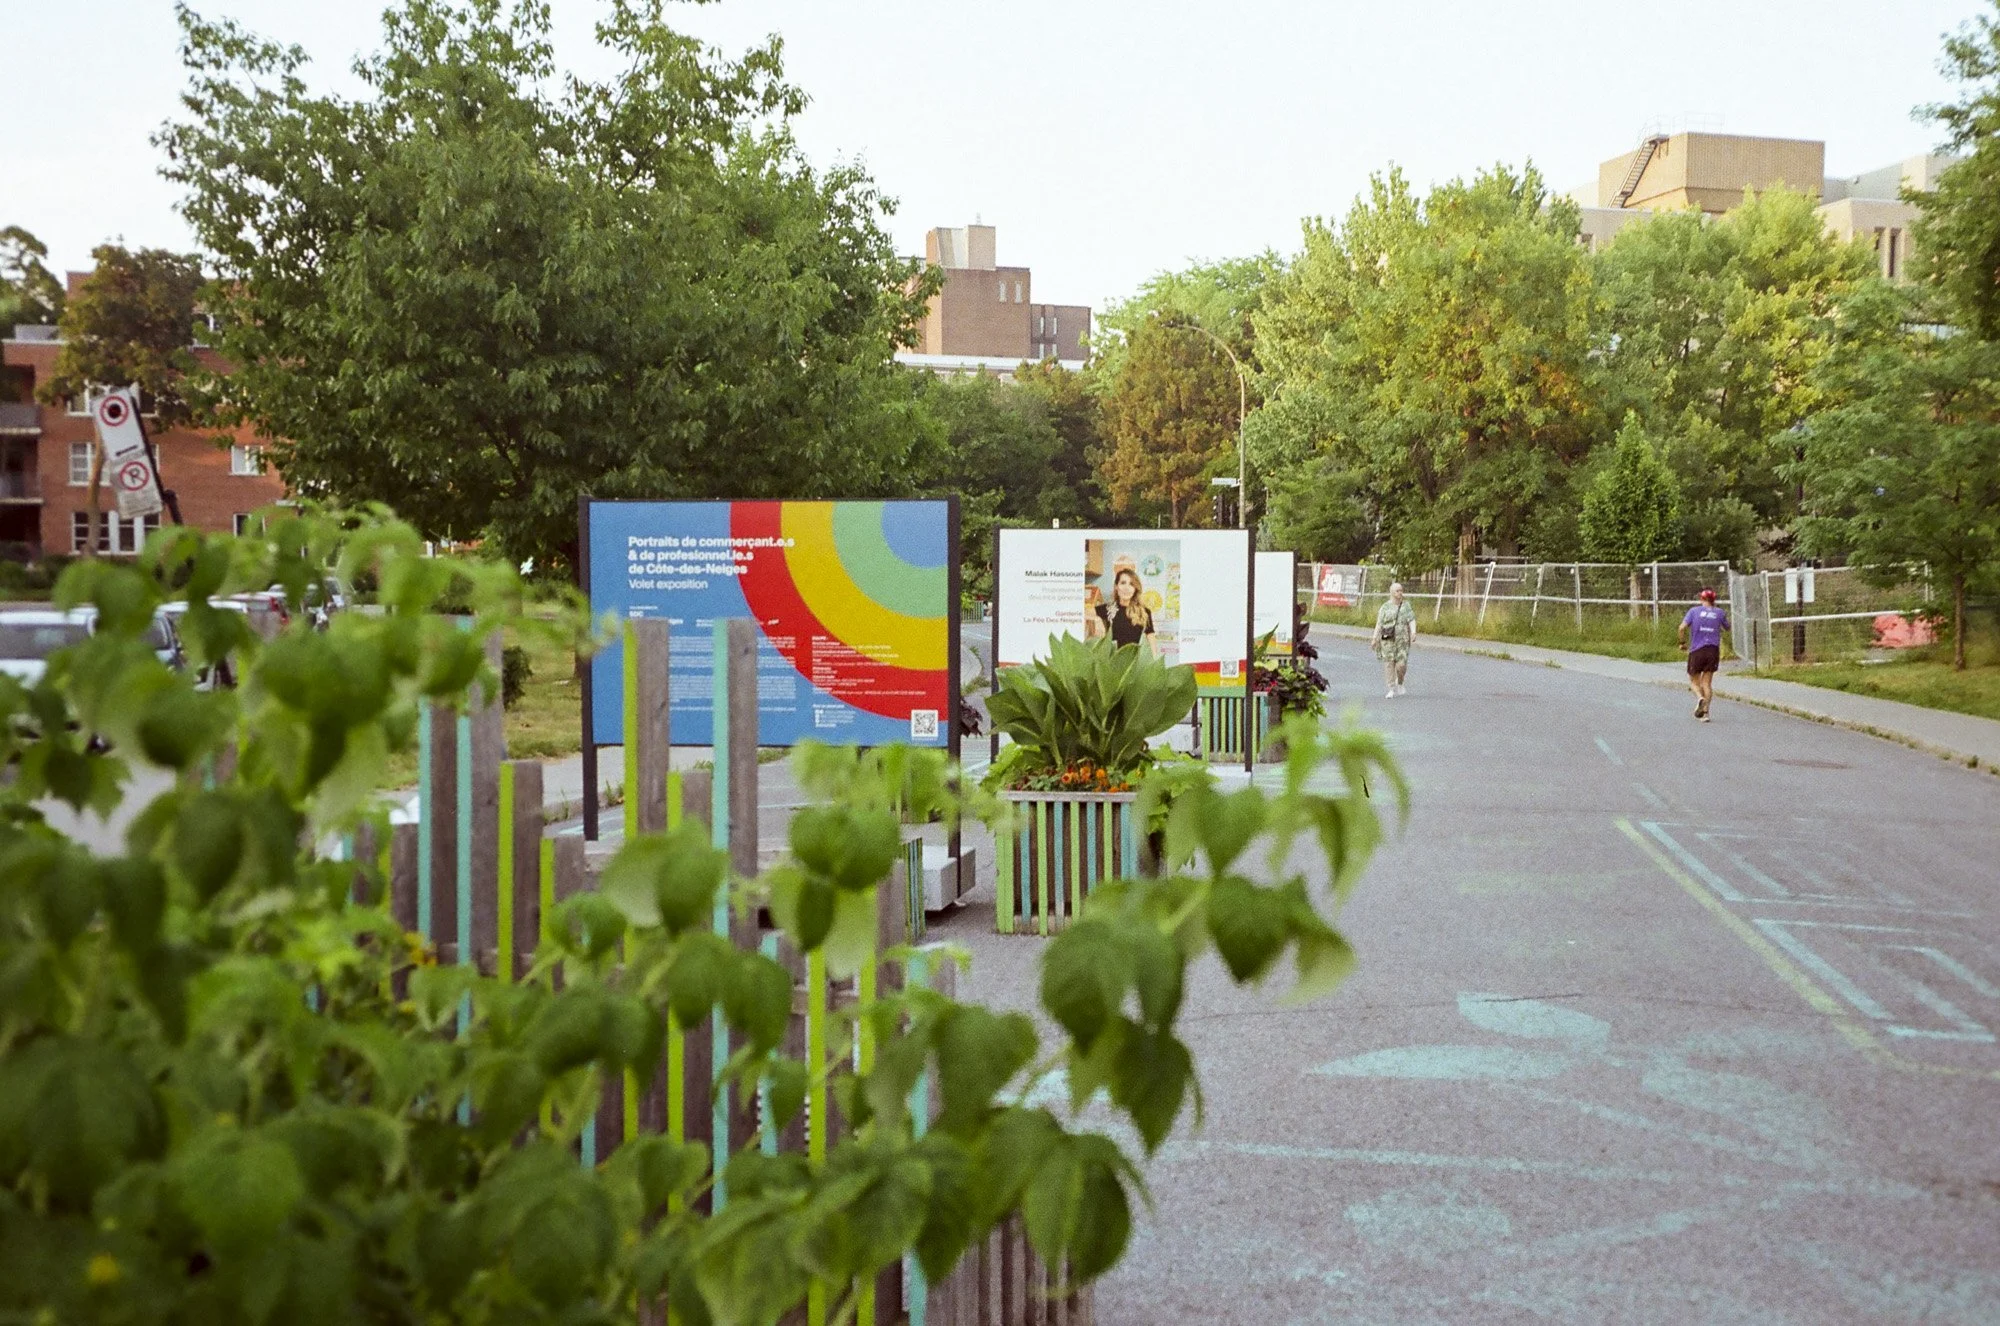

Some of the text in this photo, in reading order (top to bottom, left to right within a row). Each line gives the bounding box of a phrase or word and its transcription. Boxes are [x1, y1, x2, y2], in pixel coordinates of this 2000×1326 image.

[628, 536, 795, 549] Portraits de commerçant.e.s
[628, 550, 638, 561] &
[639, 550, 654, 561] de
[628, 563, 748, 576] de Côte-des-Neiges
[628, 579, 708, 590] Volet exposition
